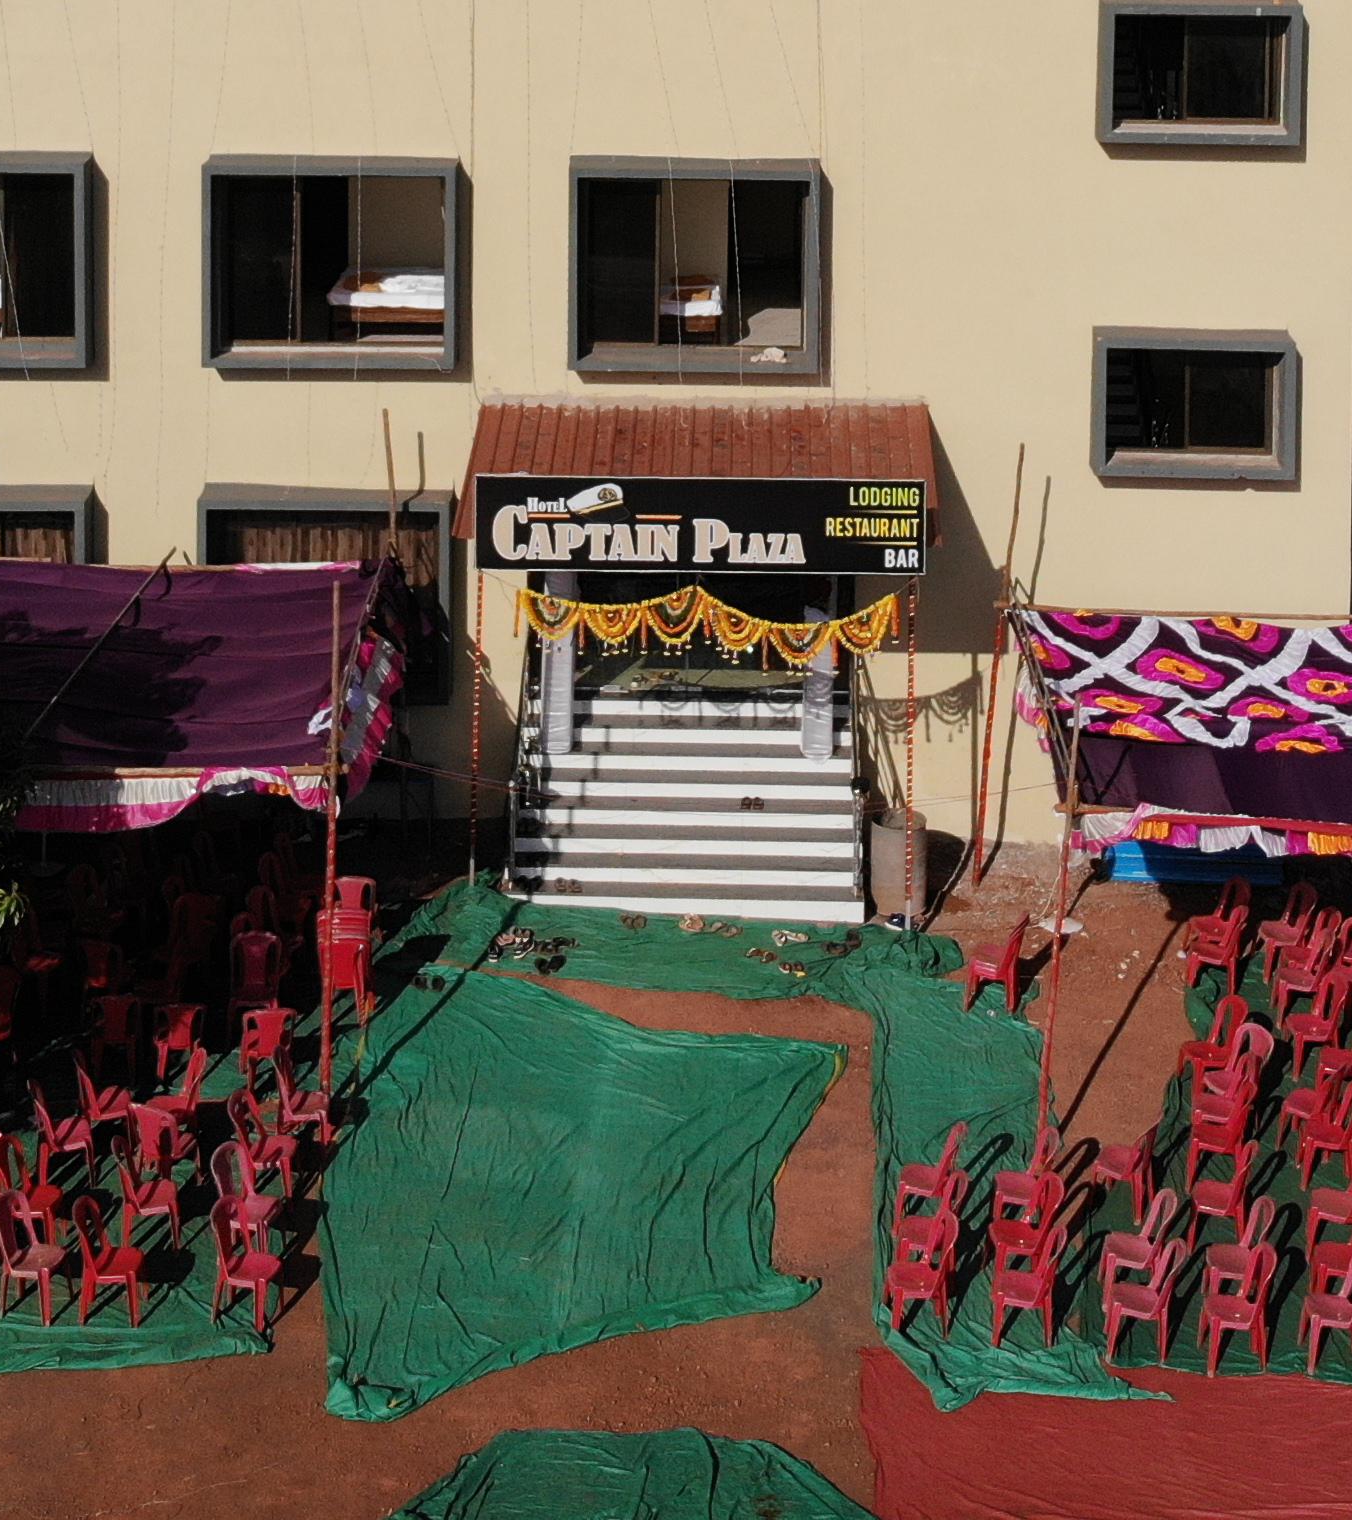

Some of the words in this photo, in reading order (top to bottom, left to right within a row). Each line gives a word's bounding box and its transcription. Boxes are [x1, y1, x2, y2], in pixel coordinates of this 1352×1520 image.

[527, 496, 568, 513] HOTEL
[849, 486, 920, 507] LODGING
[492, 504, 680, 562] CAPTAIN
[692, 518, 806, 564] PLAZA
[825, 517, 920, 538] RESTAURANT
[884, 548, 919, 568] BAR
